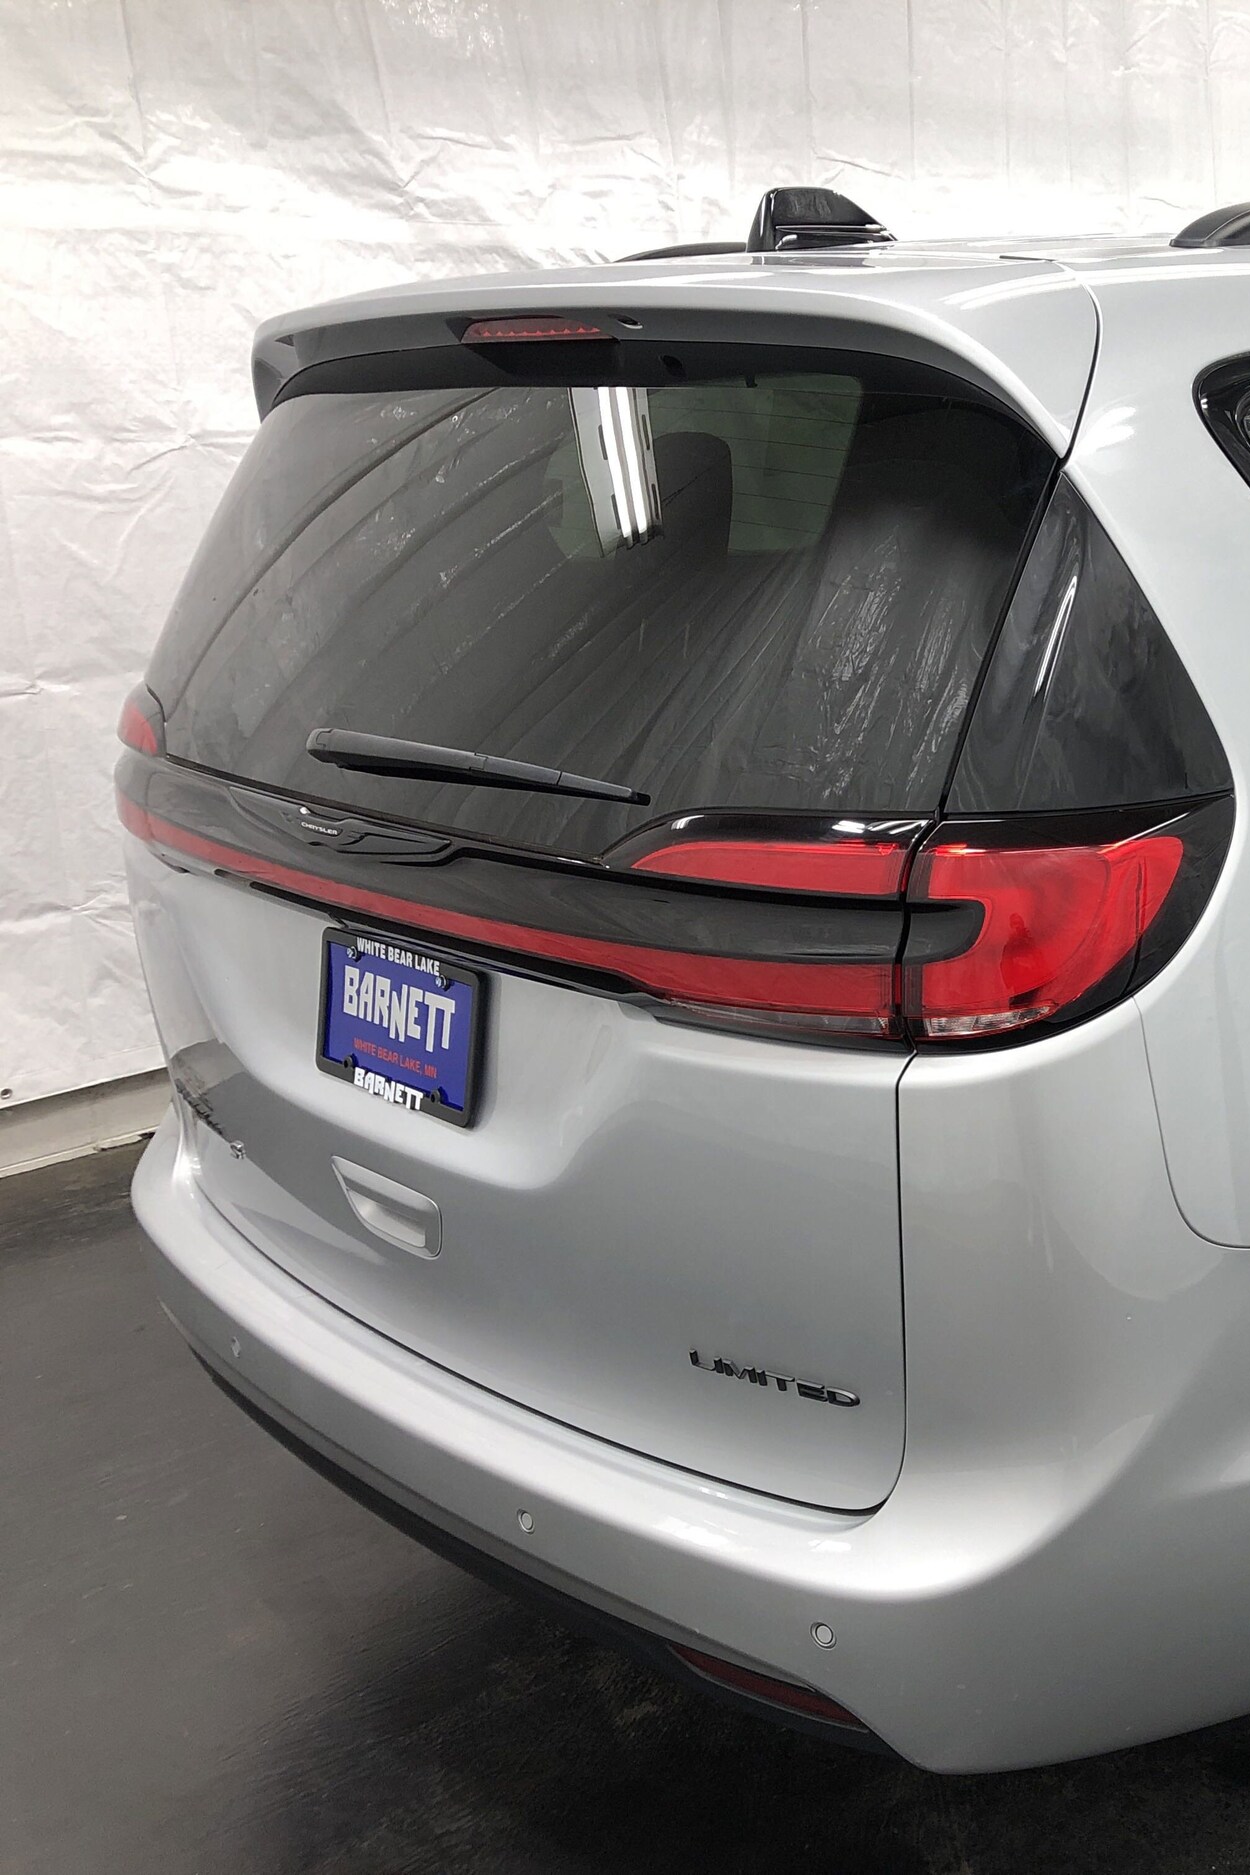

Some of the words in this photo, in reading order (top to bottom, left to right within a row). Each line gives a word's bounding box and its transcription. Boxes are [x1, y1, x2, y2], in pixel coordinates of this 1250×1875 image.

[301, 821, 338, 836] CHRYSLER
[356, 936, 386, 960] WHITE
[387, 946, 413, 968] BEAR
[414, 954, 440, 976] LAKE
[343, 964, 456, 1053] BARNETT
[353, 1037, 377, 1057] WHITE
[377, 1047, 399, 1065] BEAR
[400, 1055, 422, 1075] LAKE,
[424, 1064, 437, 1079] MN
[353, 1066, 424, 1111] BARNETT
[688, 1348, 861, 1408] LIMITED
